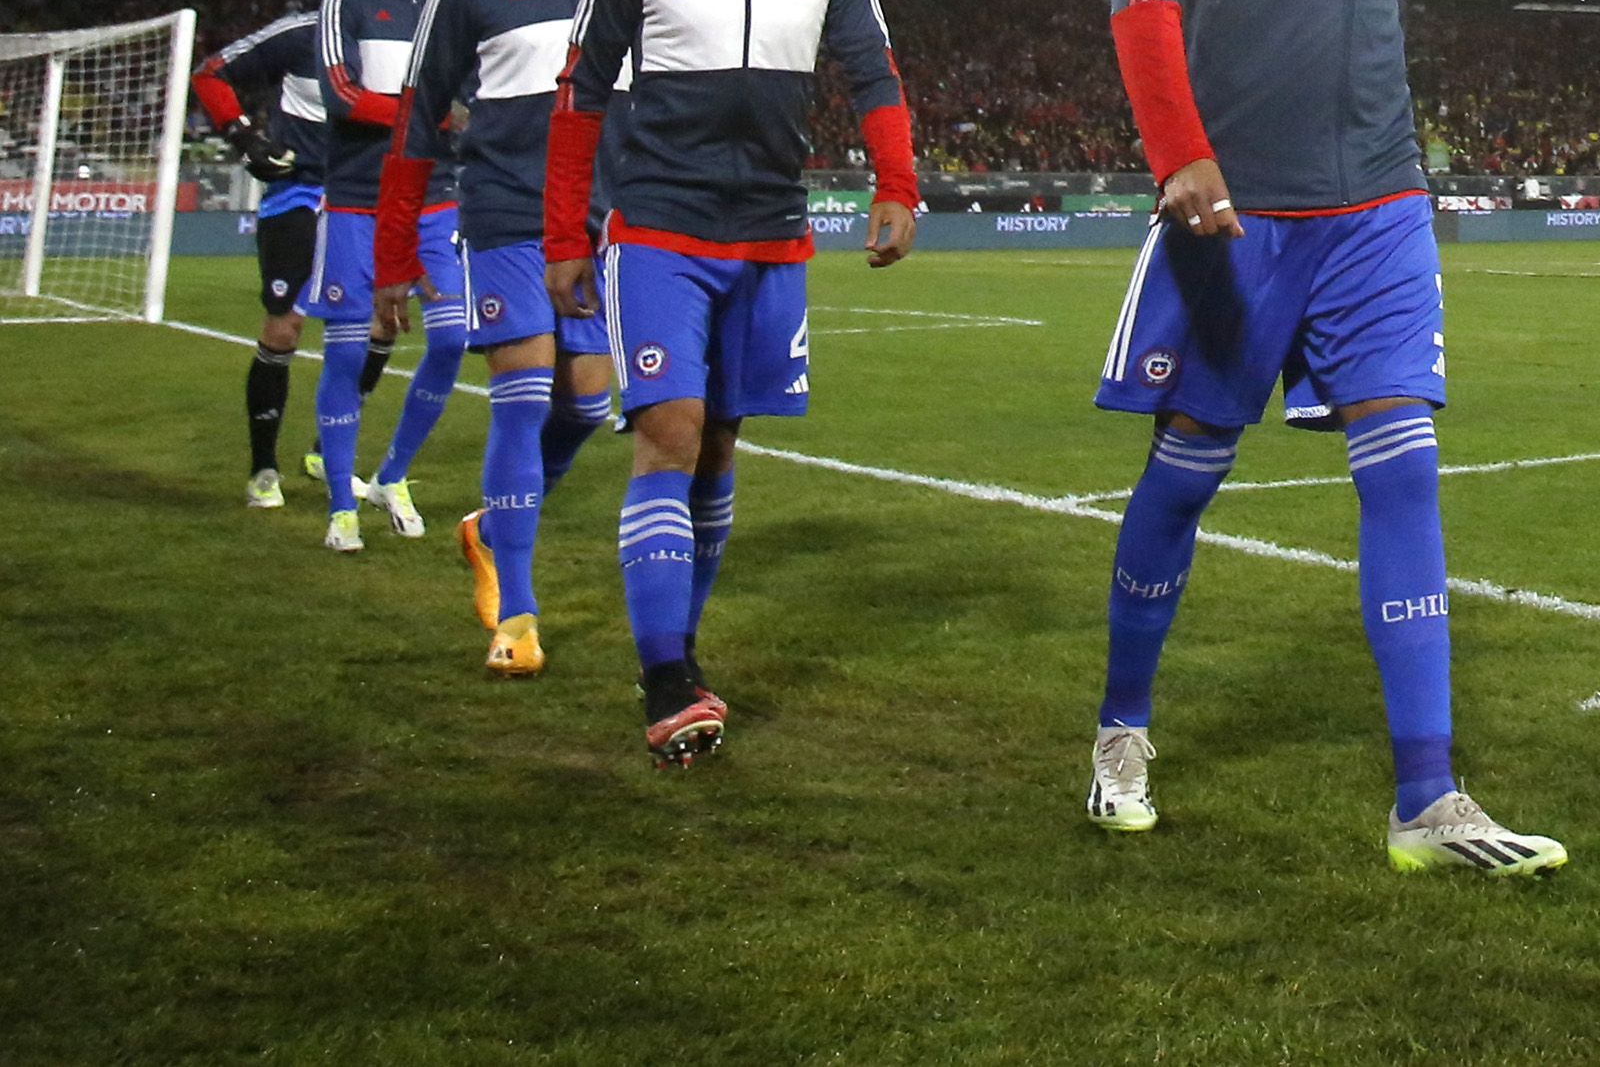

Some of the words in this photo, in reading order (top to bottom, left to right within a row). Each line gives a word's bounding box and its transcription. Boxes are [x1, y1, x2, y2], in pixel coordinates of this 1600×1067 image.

[52, 193, 147, 212] MOTOR
[806, 196, 858, 213] chs
[808, 217, 855, 233] TORY
[996, 215, 1070, 231] HISTORY
[1381, 592, 1449, 624] CHIL
